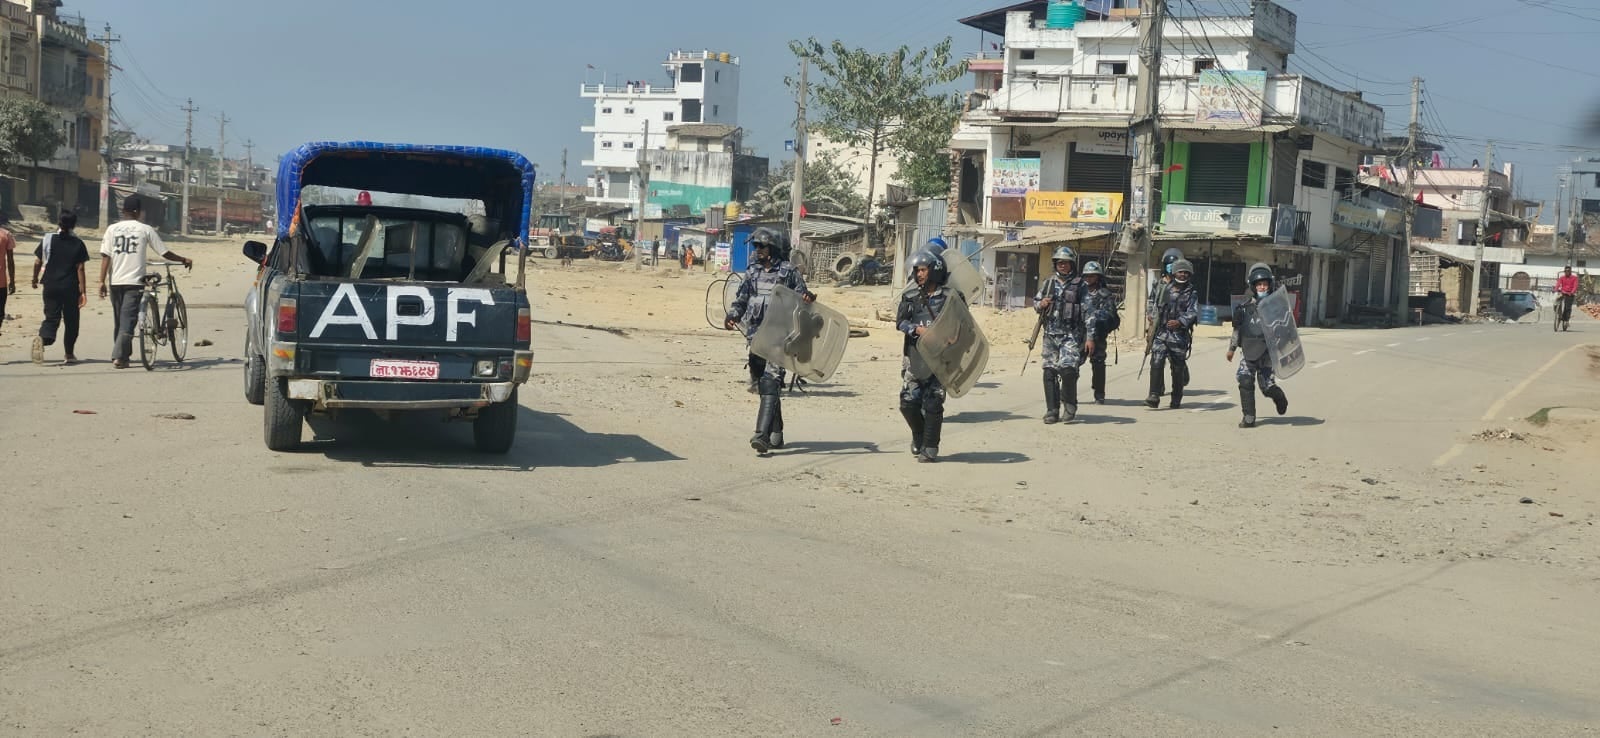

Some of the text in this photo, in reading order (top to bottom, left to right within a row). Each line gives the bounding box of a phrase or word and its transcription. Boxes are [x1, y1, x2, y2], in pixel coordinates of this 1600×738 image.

[1037, 199, 1065, 207] LITMUS
[1183, 208, 1201, 221] सेवा
[1204, 209, 1242, 222] मेडिल
[308, 283, 495, 342] APF
